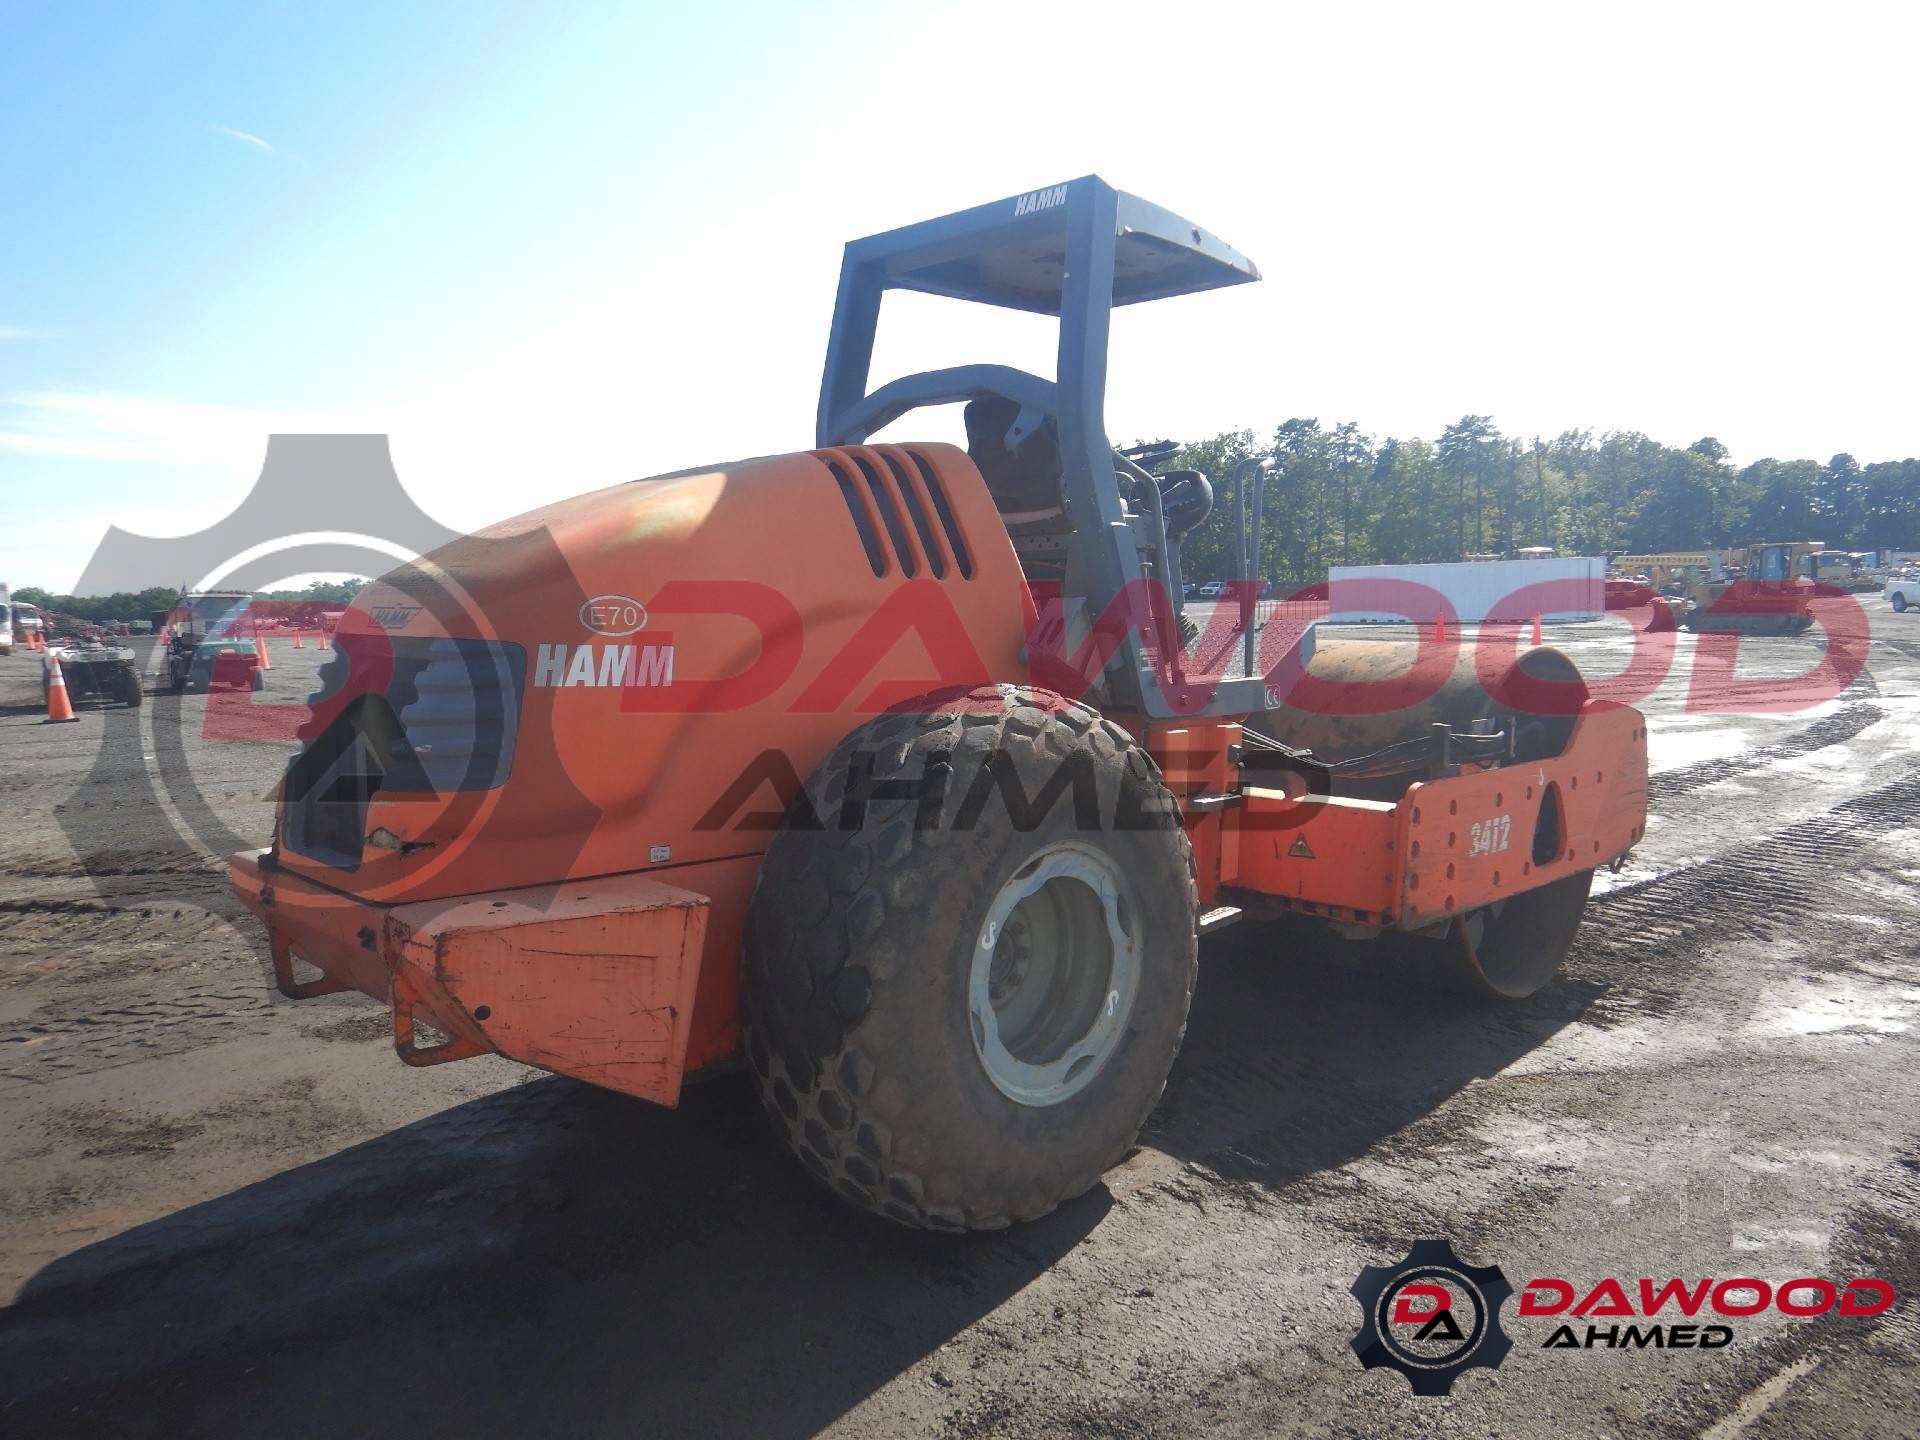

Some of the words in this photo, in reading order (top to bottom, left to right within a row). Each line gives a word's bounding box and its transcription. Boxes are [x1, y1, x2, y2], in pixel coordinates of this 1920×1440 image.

[1014, 184, 1068, 217] HAMM
[590, 606, 637, 626] E70
[534, 643, 674, 687] HAMM
